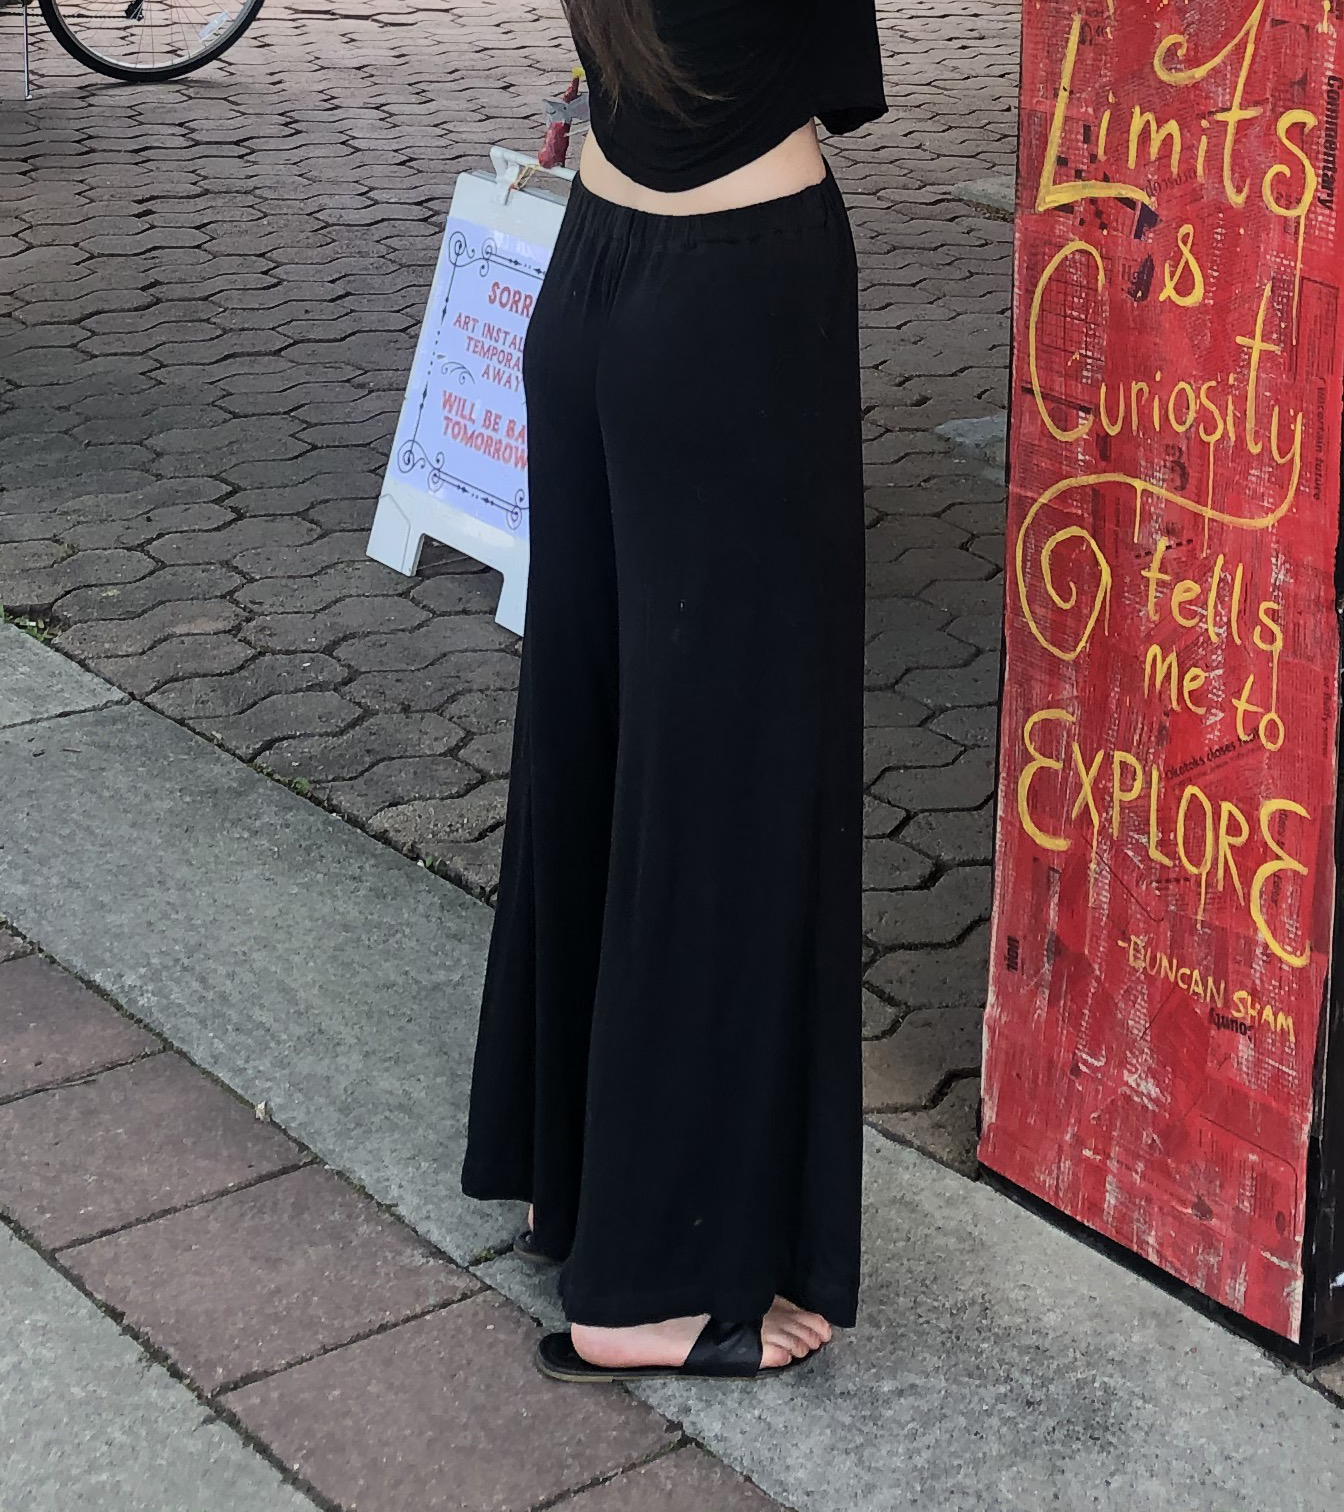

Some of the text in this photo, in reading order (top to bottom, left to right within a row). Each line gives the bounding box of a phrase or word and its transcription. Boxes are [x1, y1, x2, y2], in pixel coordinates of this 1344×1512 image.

[453, 312, 479, 334] ART
[481, 363, 523, 392] AWAY
[441, 389, 476, 425] WILL
[482, 408, 502, 432] BE
[443, 416, 528, 473] TOMORROW
[1140, 538, 1283, 652] tells
[1231, 674, 1286, 752] to
